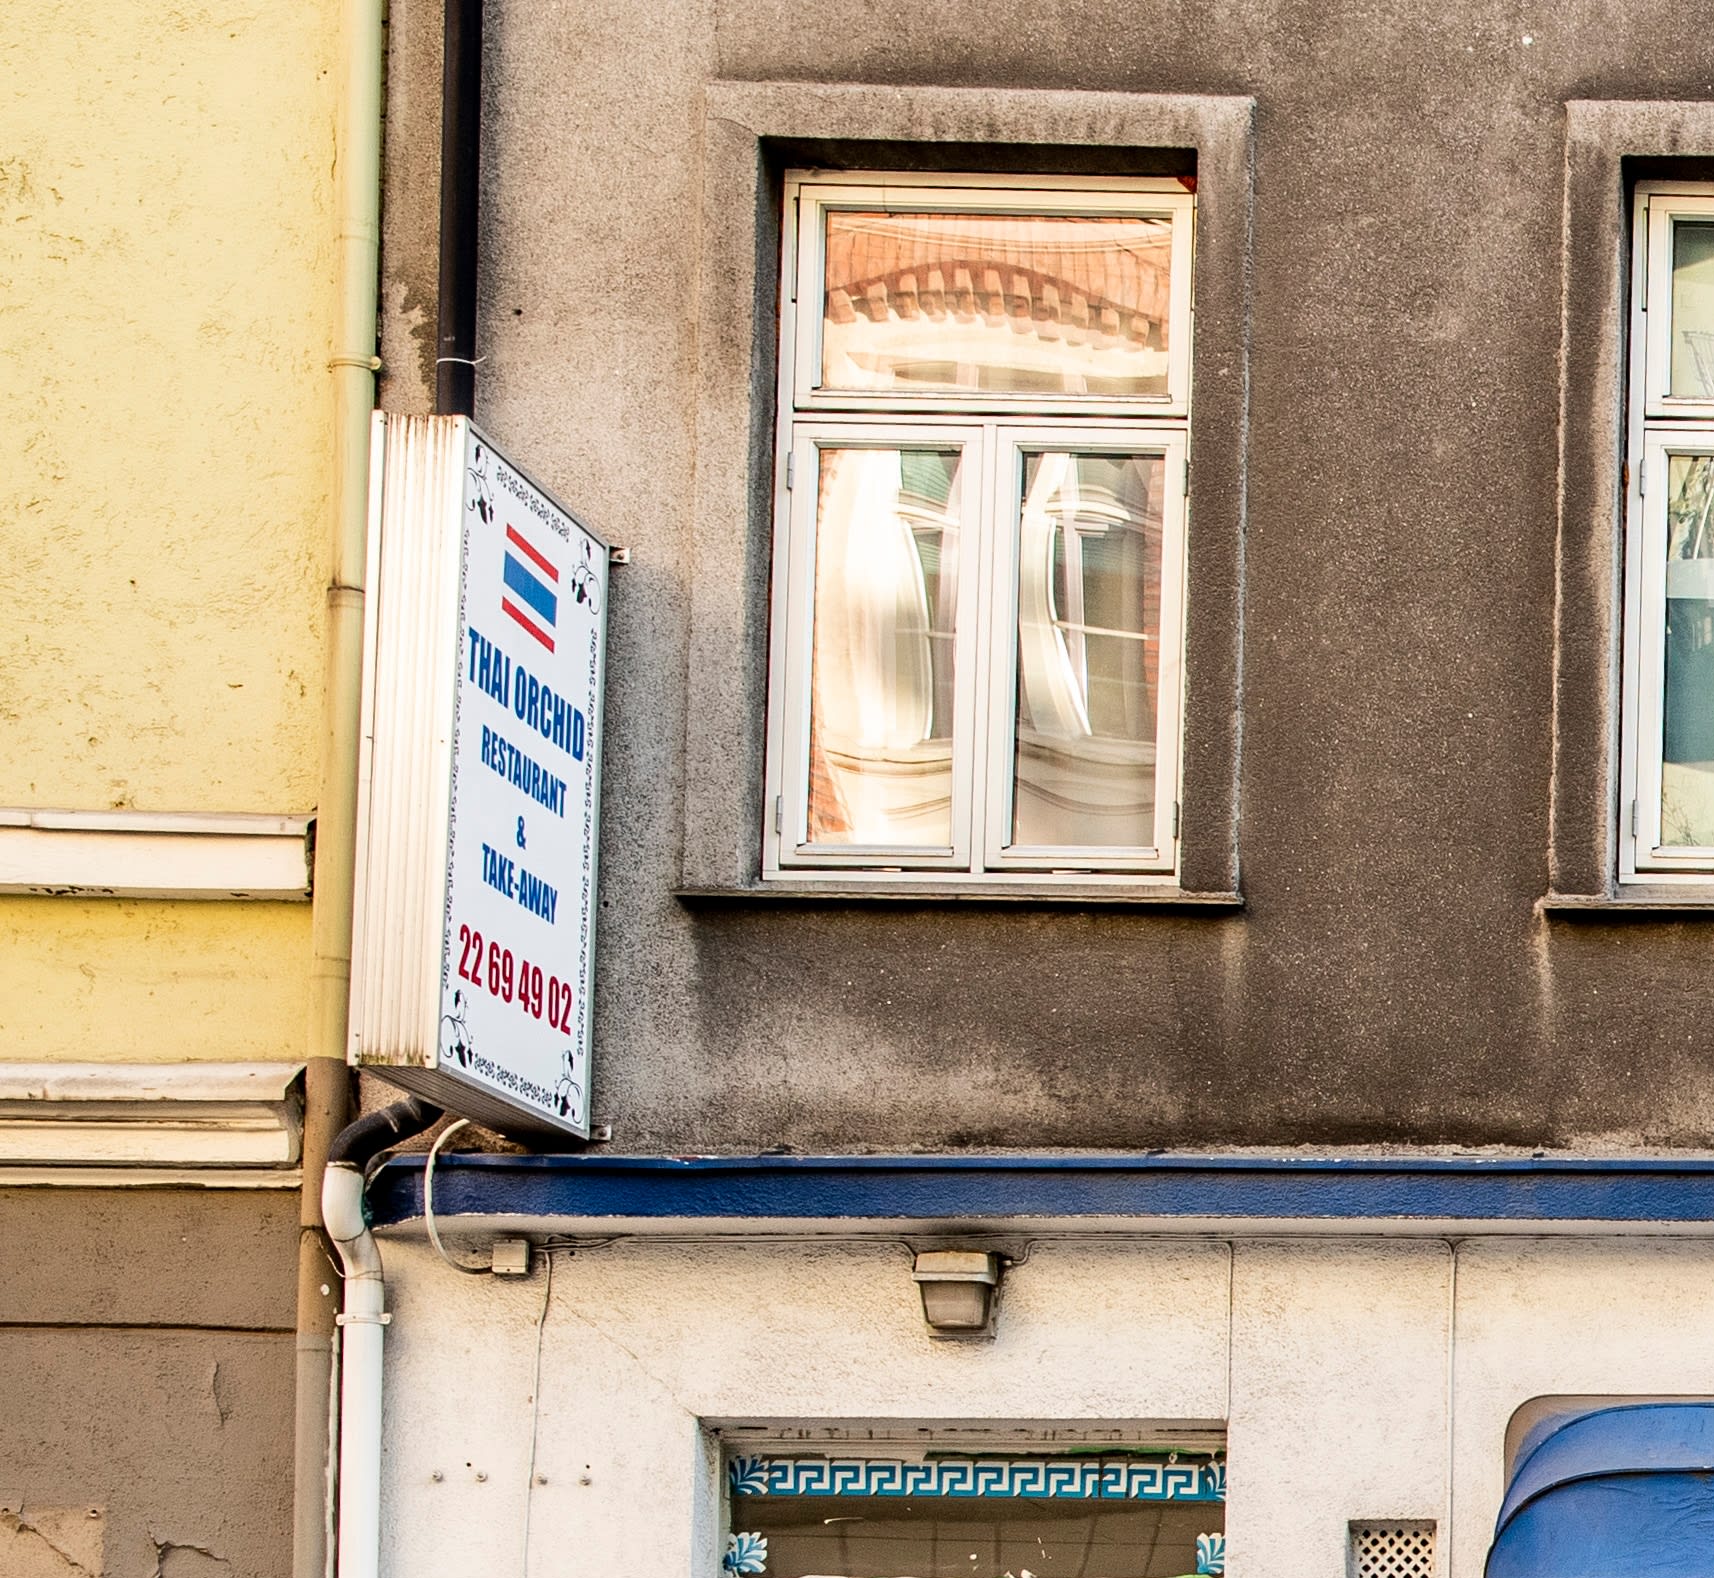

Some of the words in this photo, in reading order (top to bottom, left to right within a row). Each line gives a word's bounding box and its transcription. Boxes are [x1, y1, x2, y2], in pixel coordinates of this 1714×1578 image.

[467, 627, 511, 708] THAI
[512, 665, 586, 763] ORCHID
[480, 724, 567, 817] RESTAURANT
[514, 815, 526, 849] &
[480, 842, 558, 924] TAKE-AWAY
[458, 924, 483, 986] 22
[488, 943, 513, 1003] 69
[518, 961, 543, 1019] 49
[548, 976, 573, 1035] 02
